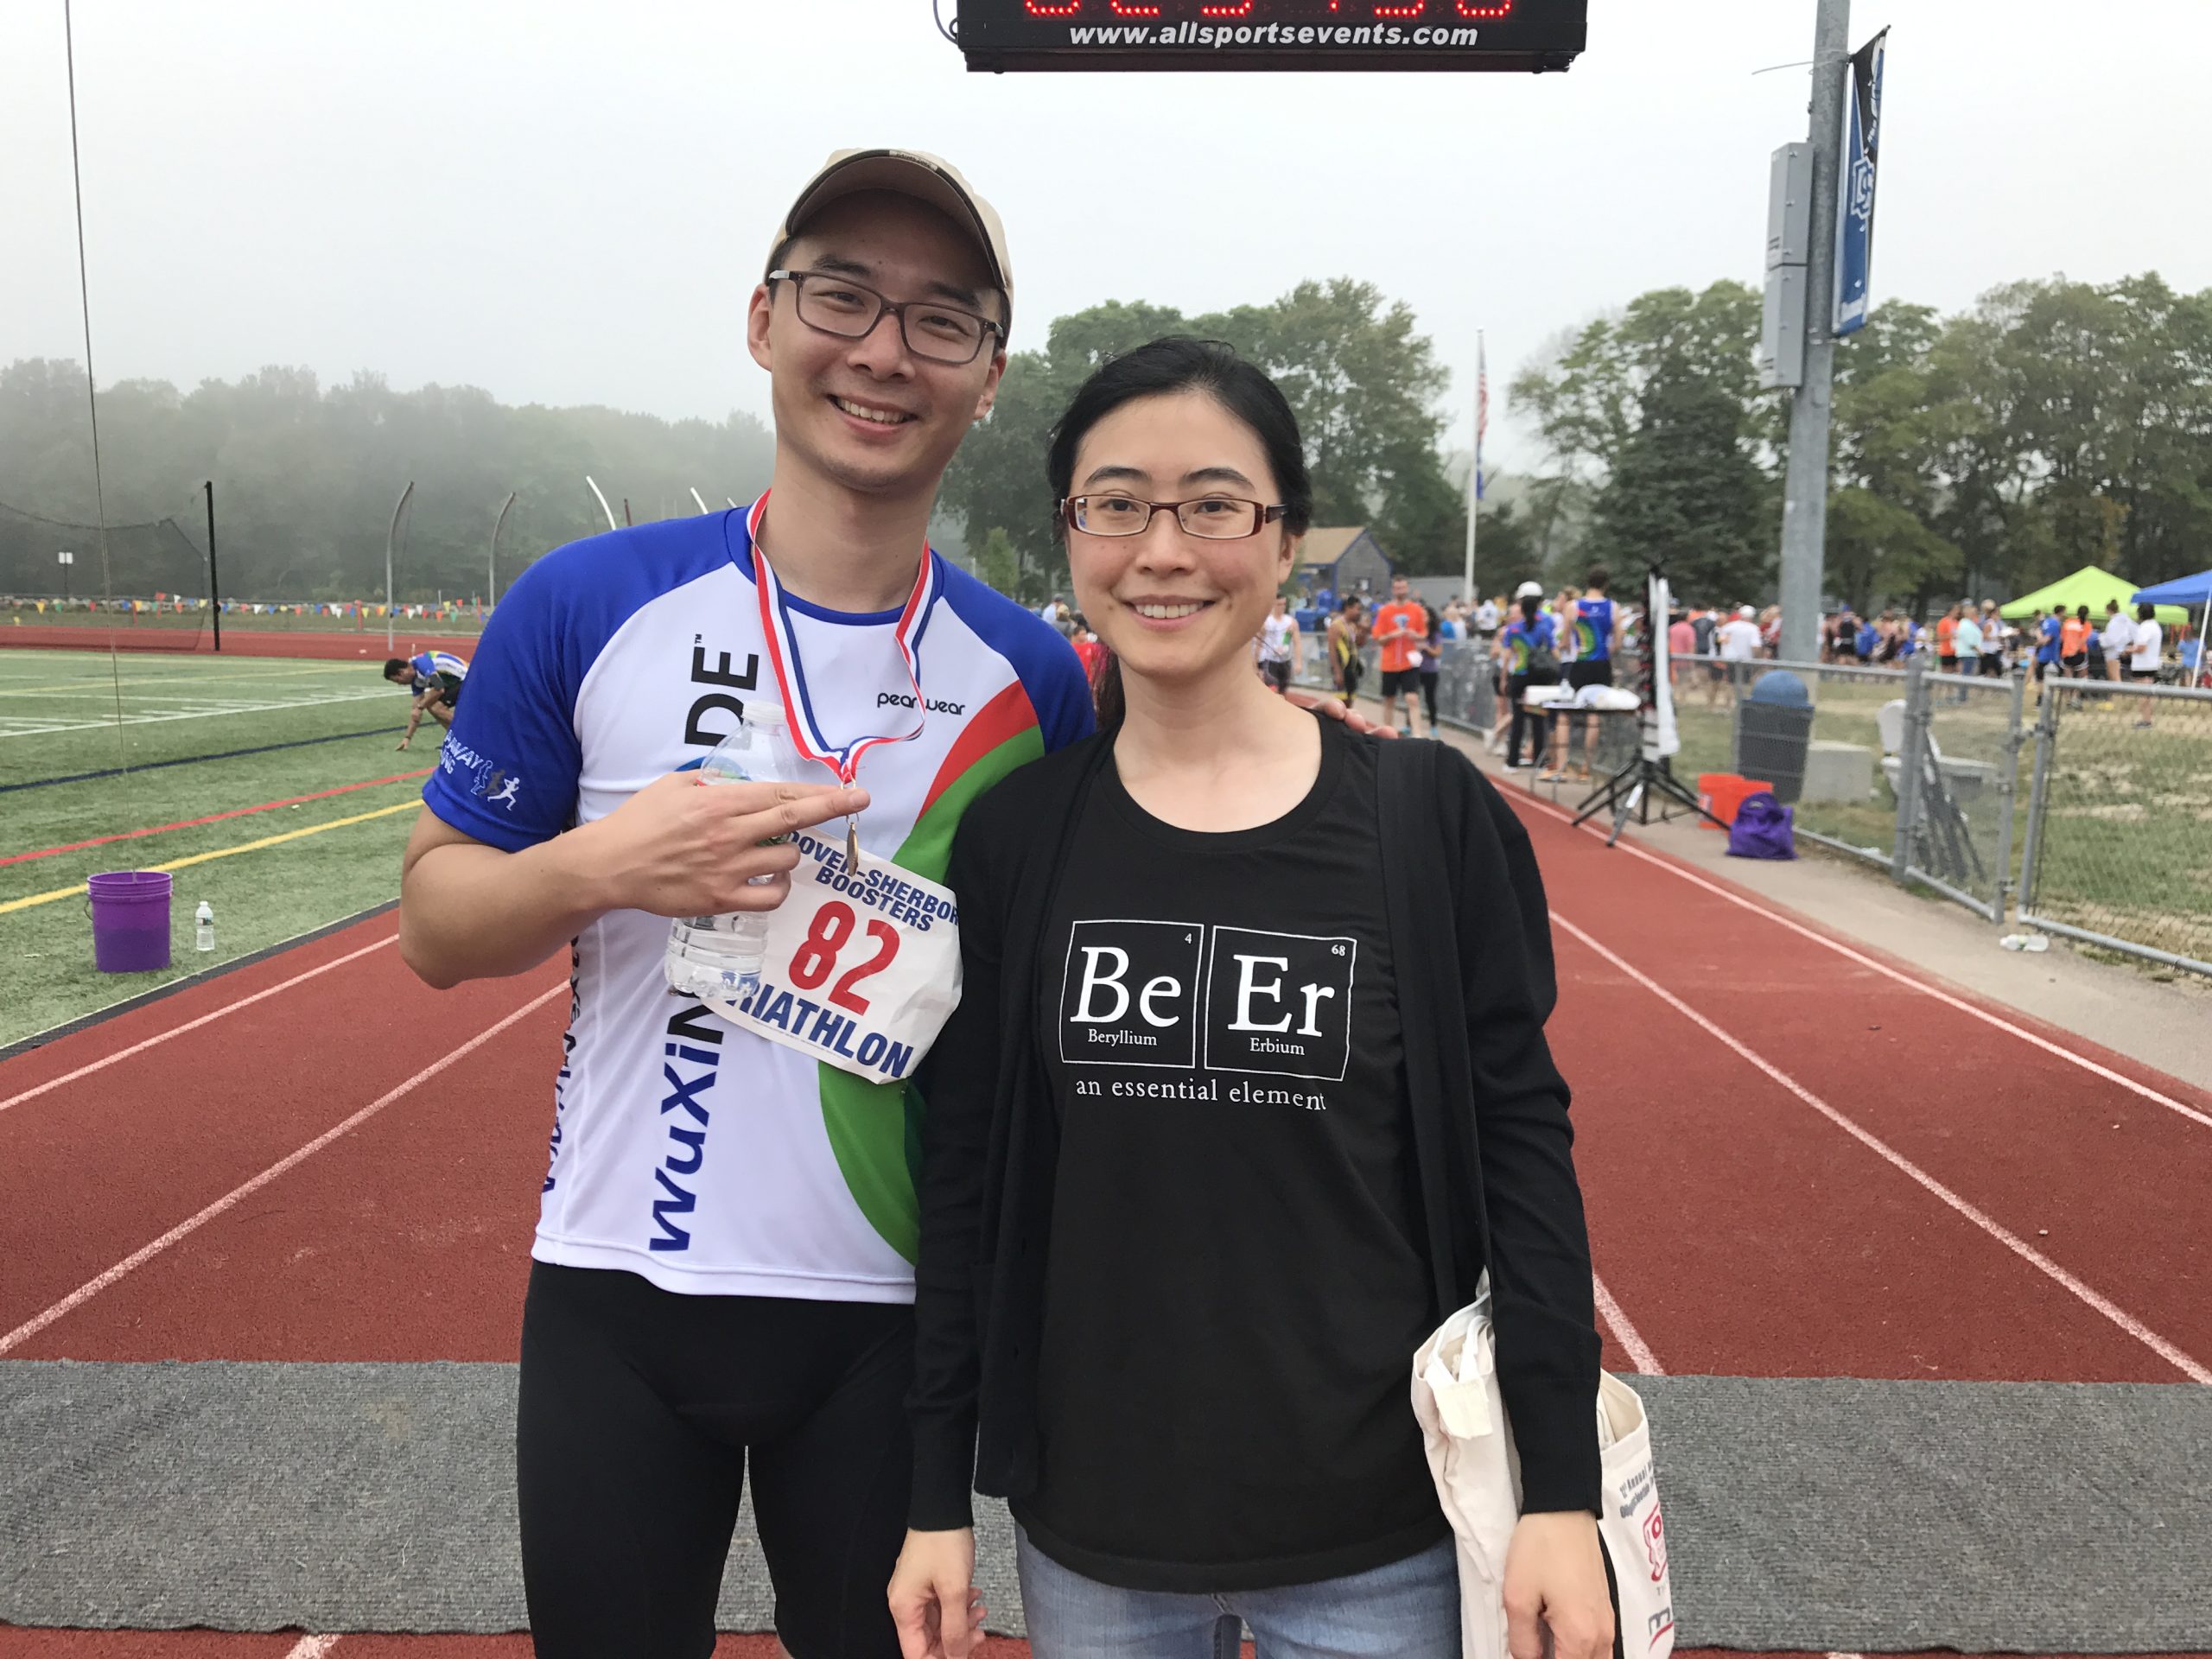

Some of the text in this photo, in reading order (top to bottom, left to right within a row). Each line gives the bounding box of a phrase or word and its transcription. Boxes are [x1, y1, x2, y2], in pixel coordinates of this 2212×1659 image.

[1070, 22, 1478, 48] www.allsportsevents.com
[789, 830, 959, 926] OVE-SHERBOR
[815, 865, 935, 932] BOOSTERS
[1185, 933, 1193, 944] 4
[1331, 944, 1346, 957] 68
[788, 900, 900, 1016] 82
[1070, 946, 1182, 1027] Be
[1227, 954, 1336, 1038] Er
[1087, 1028, 1158, 1048] Beryllium
[1249, 1038, 1306, 1056] Erbium
[1076, 1077, 1327, 1111] an essential element
